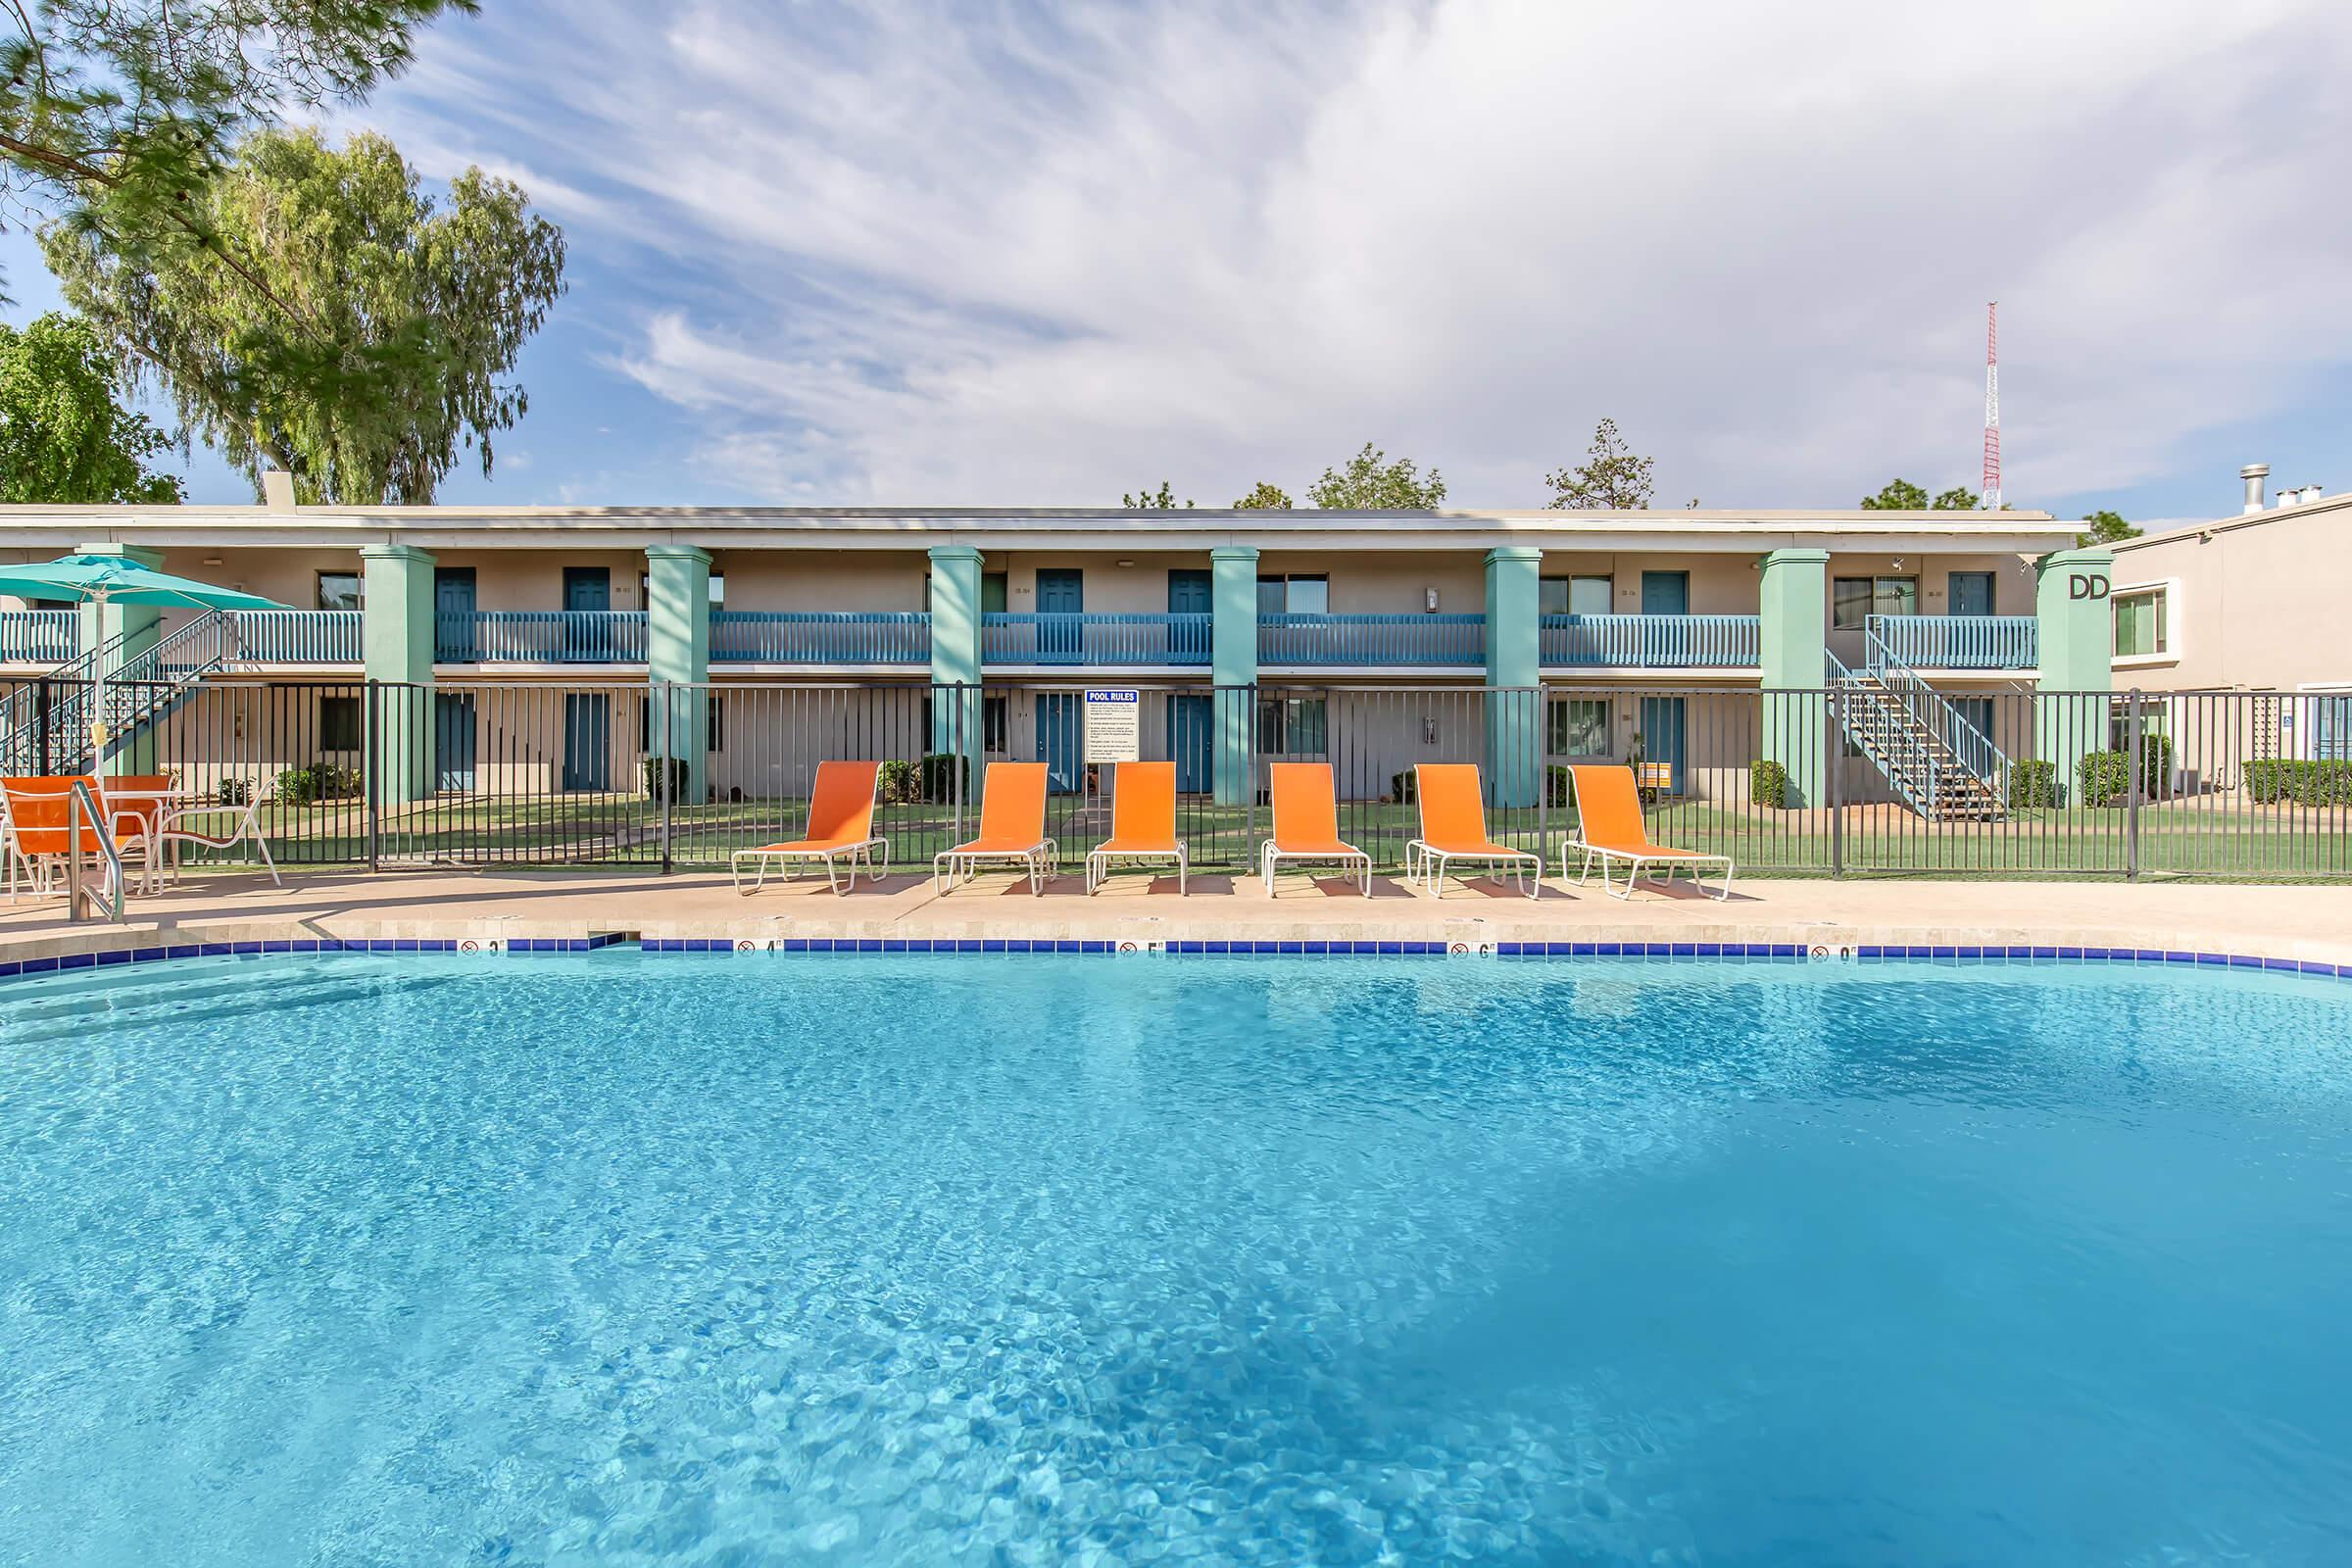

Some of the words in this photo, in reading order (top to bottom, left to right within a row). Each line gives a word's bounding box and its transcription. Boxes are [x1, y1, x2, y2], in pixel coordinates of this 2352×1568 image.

[2070, 574, 2110, 599] DD
[1090, 692, 1109, 701] POOL
[1110, 692, 1135, 701] RULES
